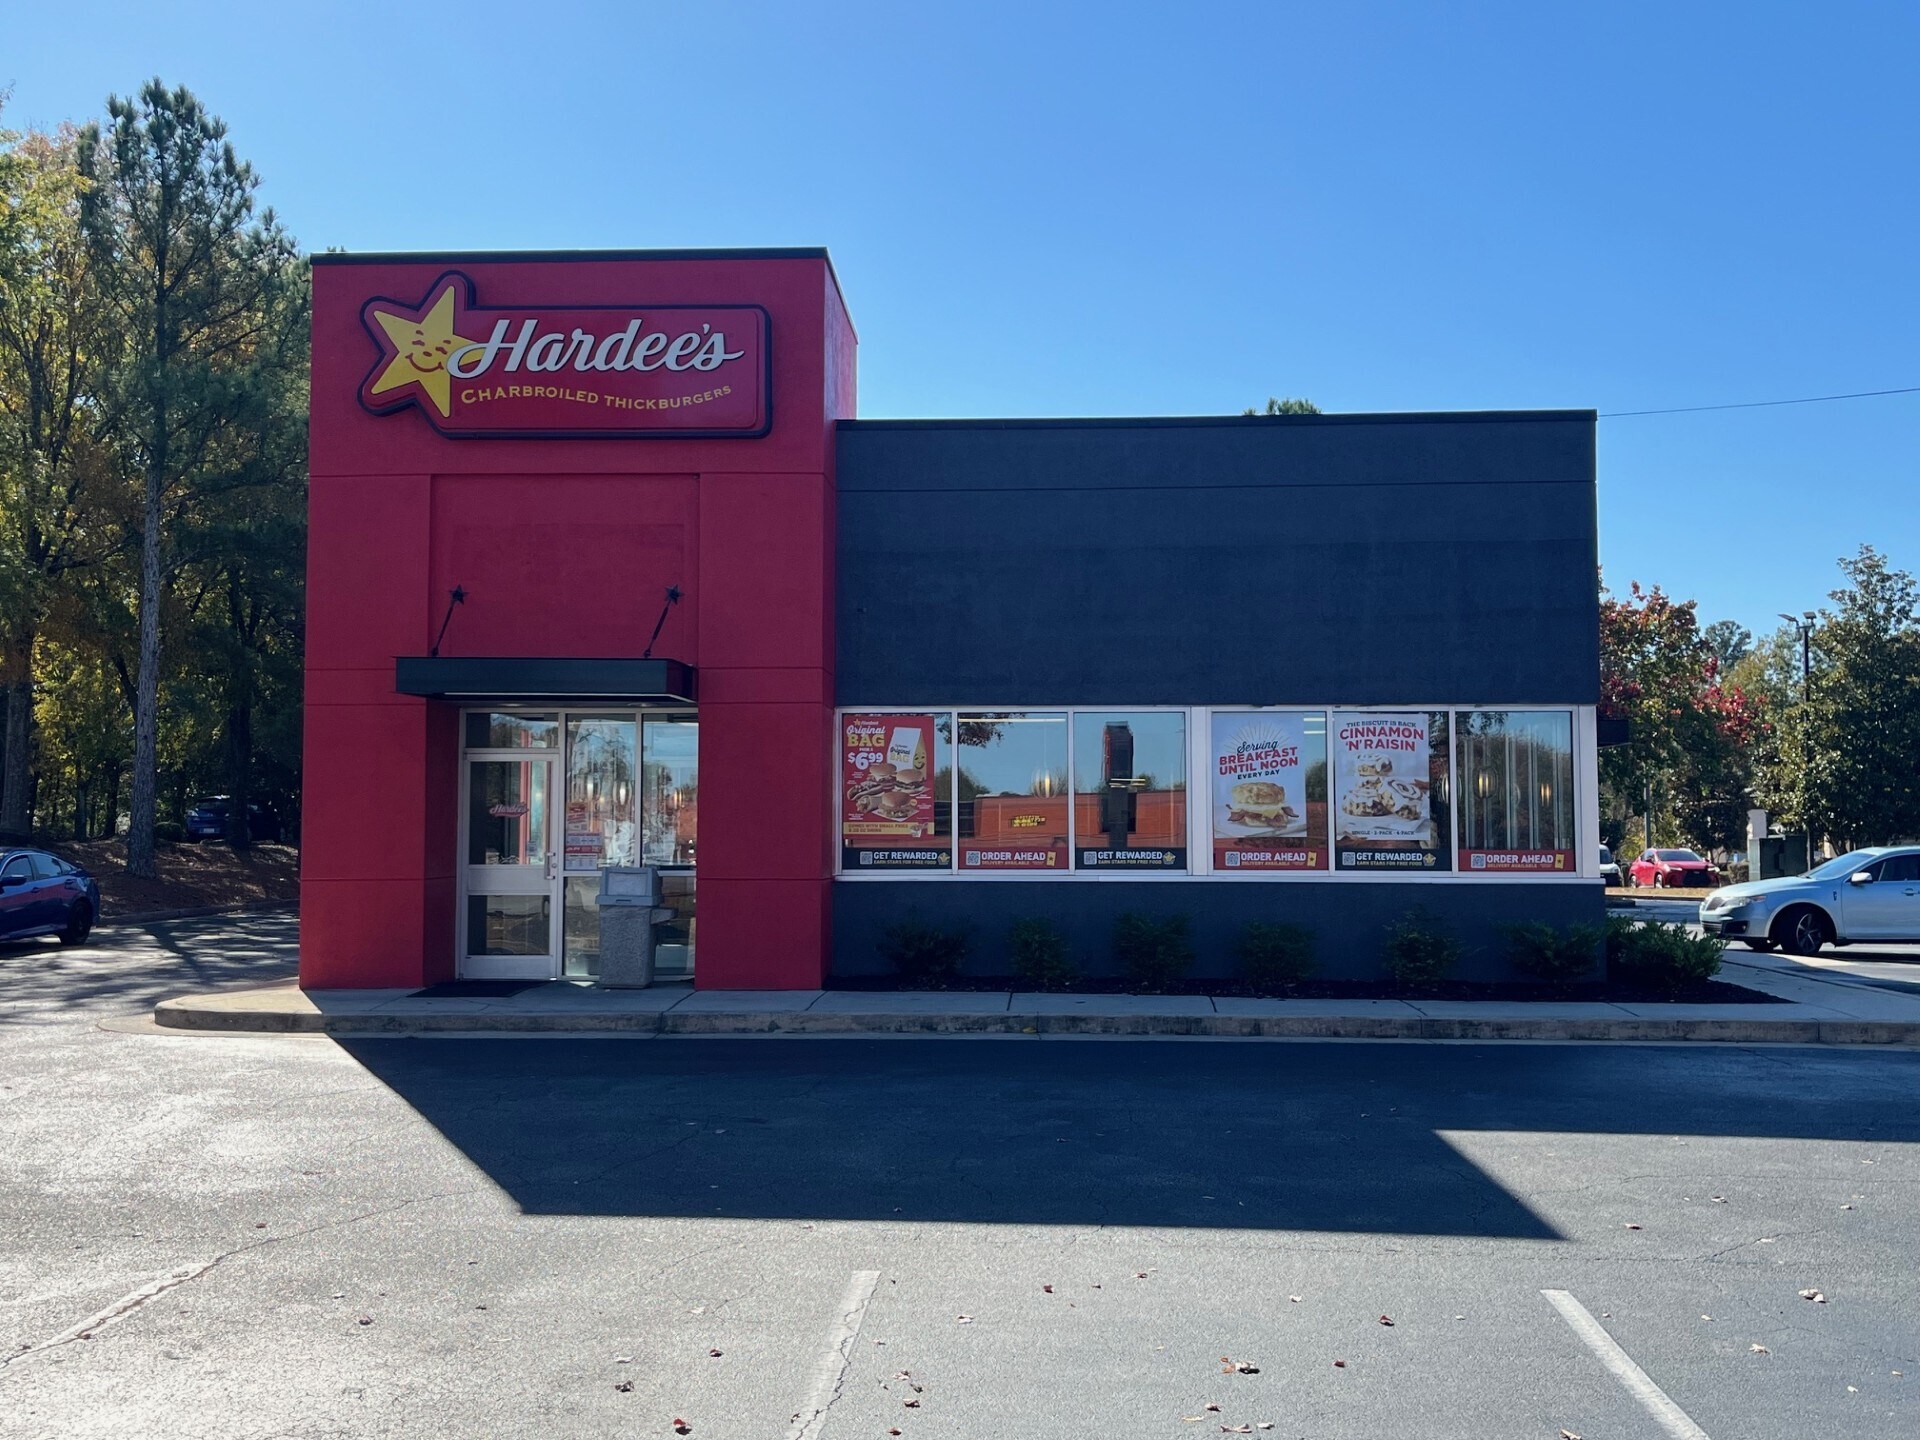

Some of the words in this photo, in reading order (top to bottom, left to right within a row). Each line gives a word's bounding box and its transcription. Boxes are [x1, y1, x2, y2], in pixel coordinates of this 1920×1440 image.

[446, 319, 745, 379] Hardee's
[461, 386, 599, 405] CHARBROILED
[604, 385, 732, 410] THICKBURGERS
[846, 725, 886, 737] Original
[1340, 726, 1424, 740] CINNAMON
[847, 734, 885, 747] BAG
[1364, 738, 1415, 752] RAISIN
[1237, 740, 1279, 754] Serving
[1219, 746, 1298, 765] BREAKFAST
[1219, 763, 1257, 775] UNTIL
[1260, 757, 1298, 770] NOON
[1237, 771, 1262, 780] EVERY
[873, 851, 889, 860] GET
[891, 851, 937, 860] REWARDED
[981, 852, 1011, 860] ORDER
[1014, 852, 1046, 860] AHEAD
[1098, 851, 1113, 859] GET
[1116, 851, 1163, 859] REWARDED
[1241, 852, 1271, 861] ORDER
[1274, 852, 1306, 861] AHEAD
[1356, 852, 1373, 861] GET
[1375, 852, 1423, 861] REWARDED
[1487, 855, 1519, 863] ORDER
[1521, 855, 1554, 863] AHEAD
